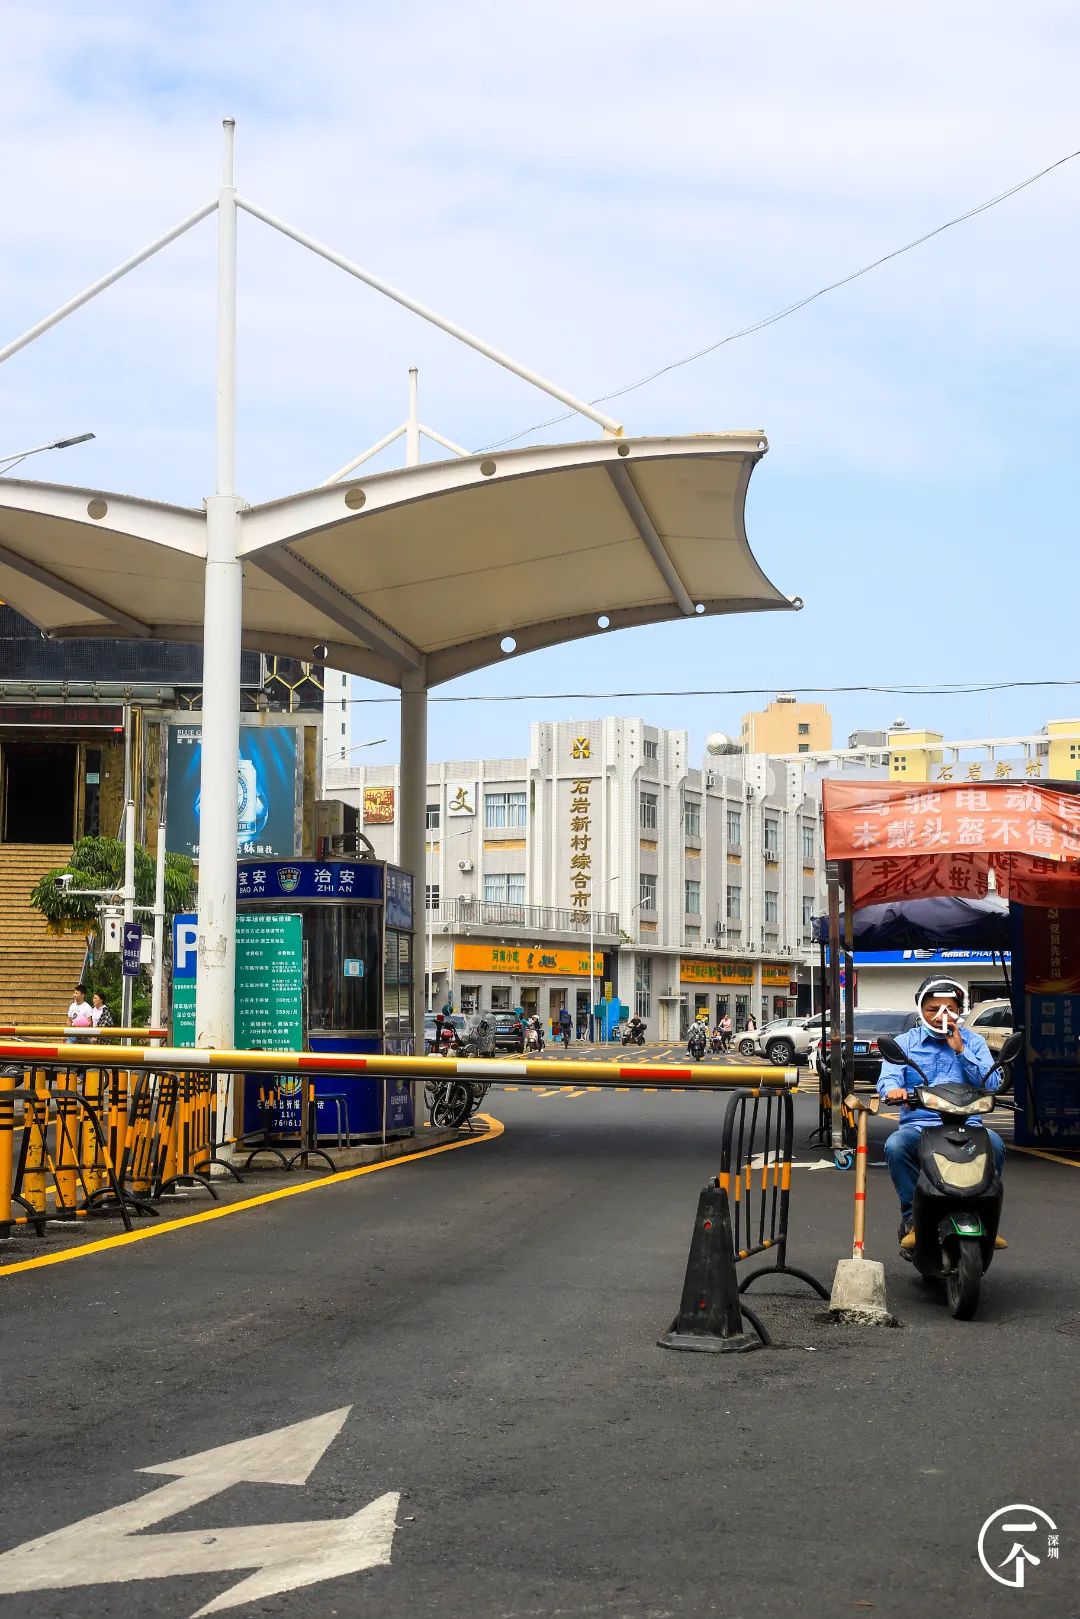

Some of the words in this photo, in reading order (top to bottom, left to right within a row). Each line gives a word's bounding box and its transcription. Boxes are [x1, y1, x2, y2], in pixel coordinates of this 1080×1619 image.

[936, 759, 1043, 781] 石岩新村
[570, 778, 592, 925] 石岩新村综合市场
[239, 869, 266, 886] 宝安
[314, 868, 355, 884] 治安
[253, 885, 265, 893] AN
[316, 884, 334, 892] ZHI
[338, 885, 352, 893] AN
[176, 923, 198, 968] P
